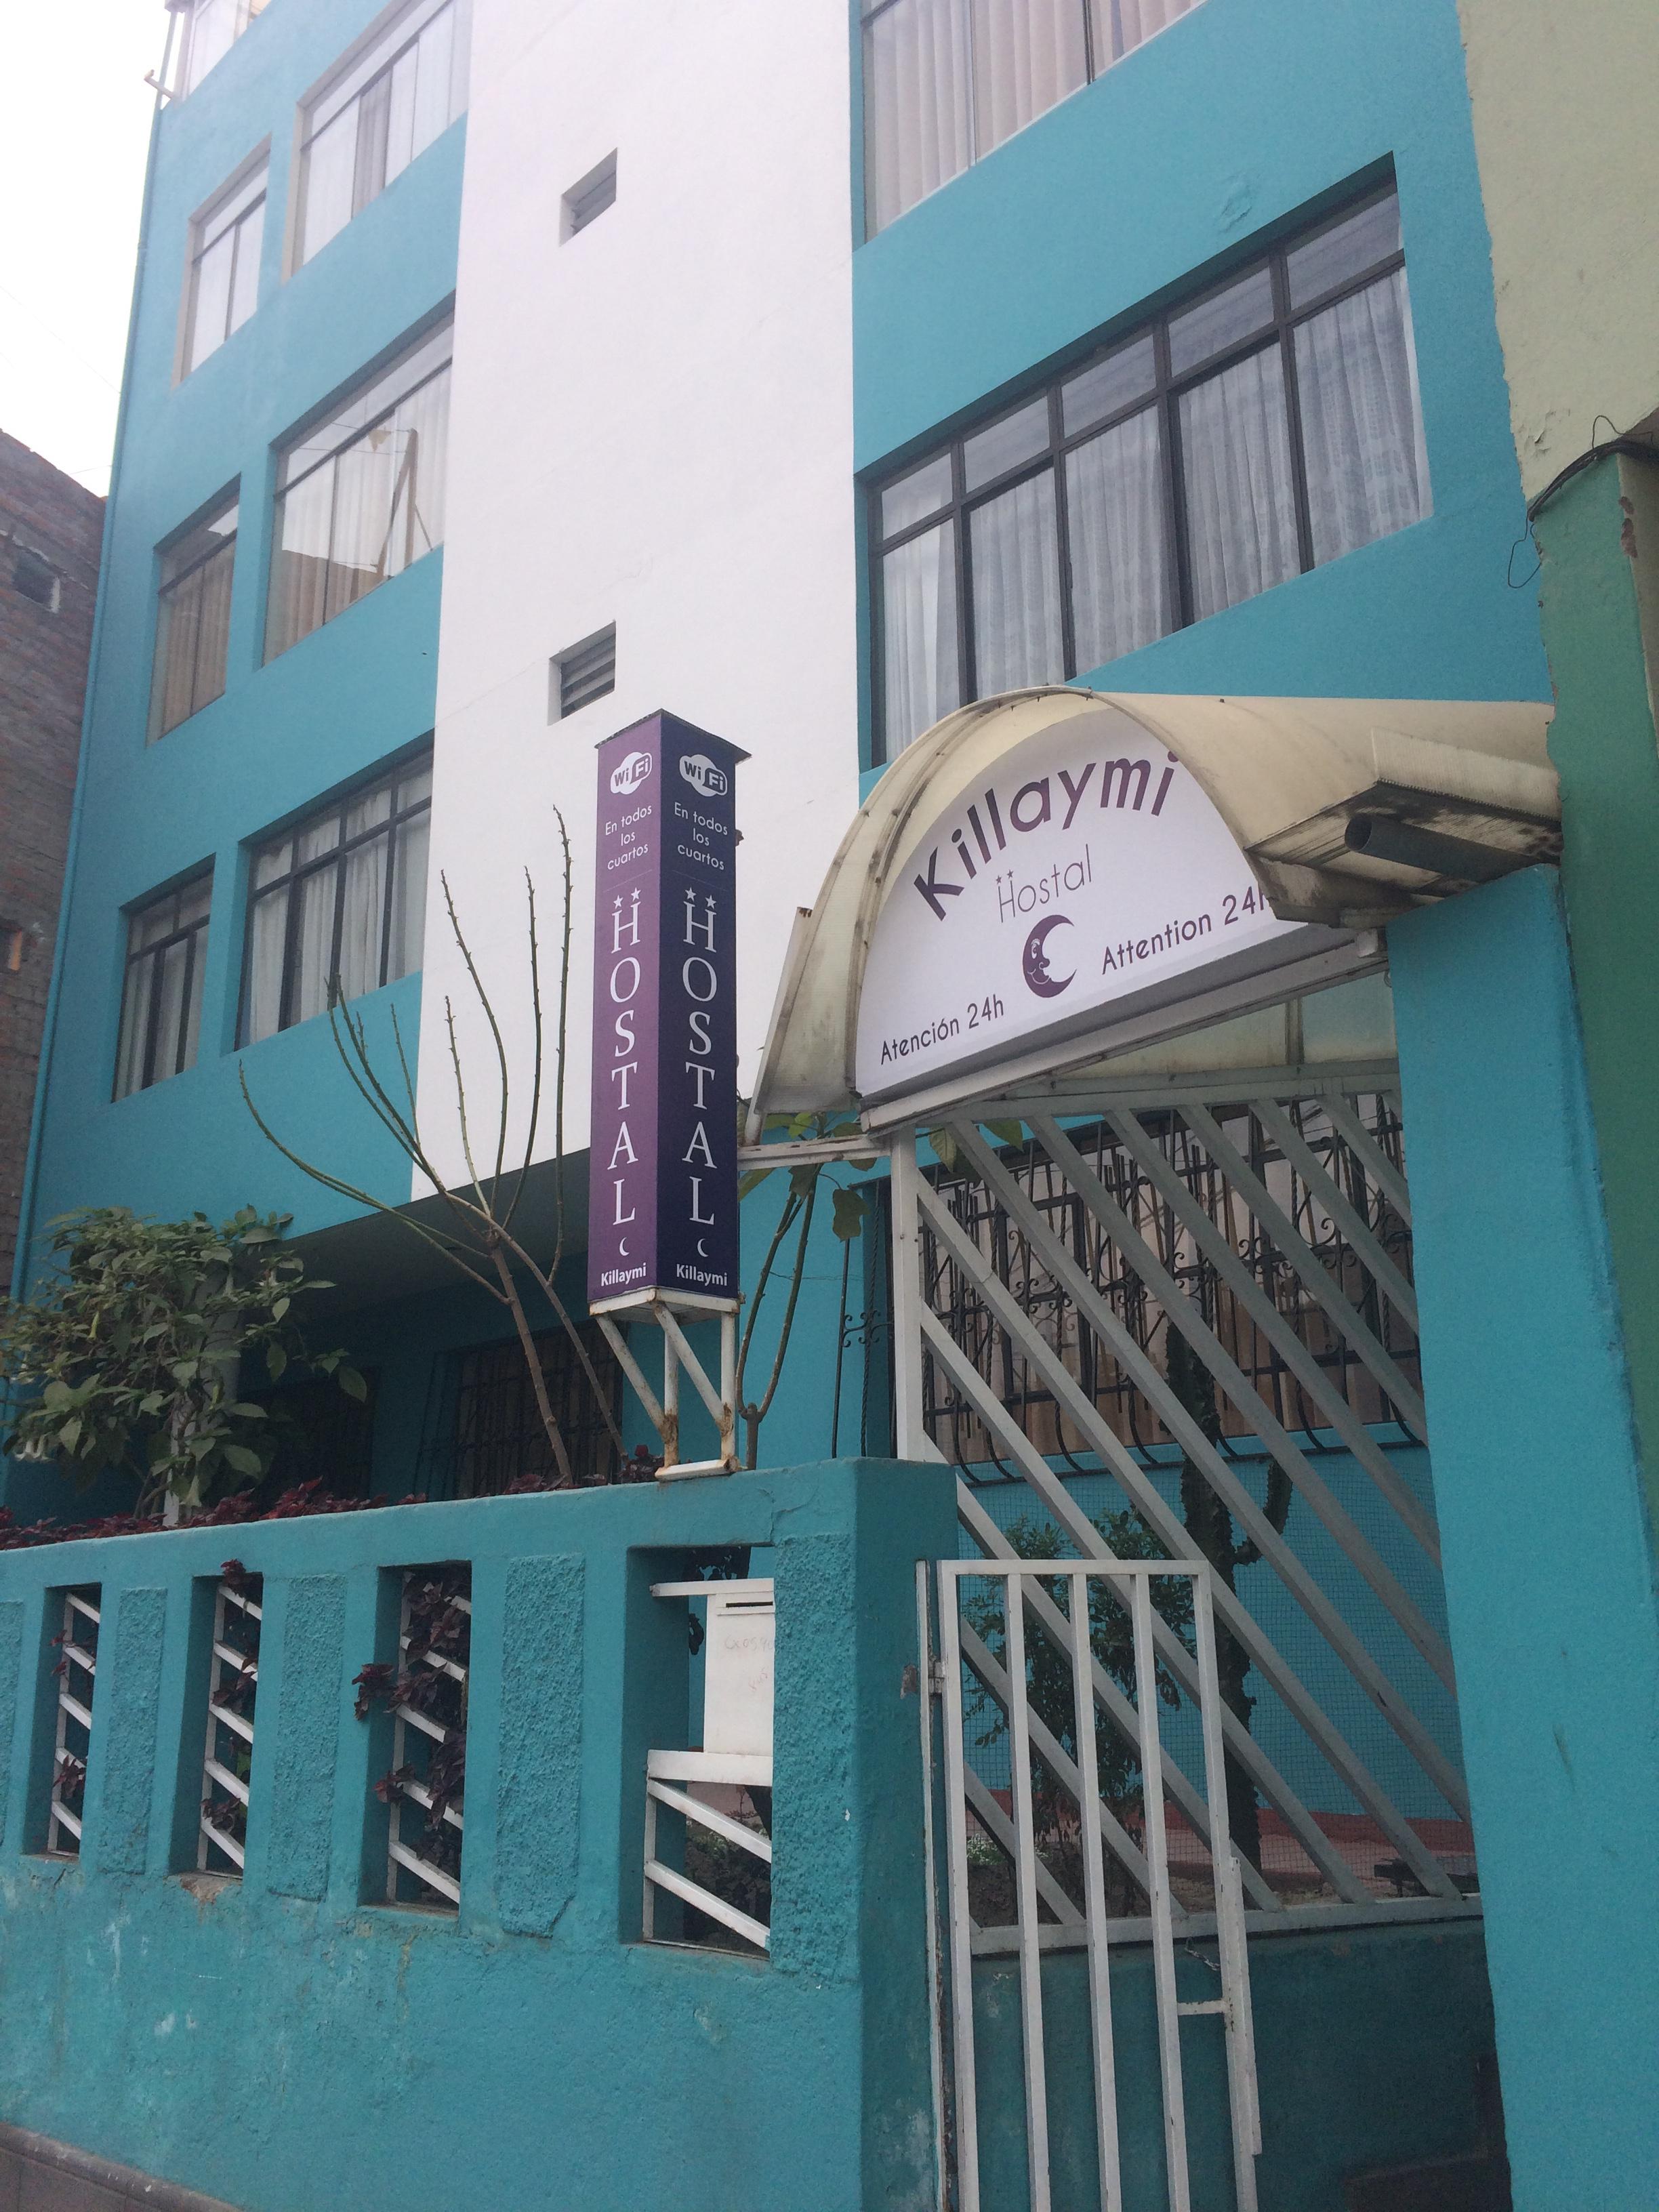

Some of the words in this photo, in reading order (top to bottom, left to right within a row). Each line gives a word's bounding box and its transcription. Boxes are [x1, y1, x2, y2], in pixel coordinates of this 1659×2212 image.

[605, 821, 618, 836] En
[621, 804, 653, 828] todos
[674, 802, 689, 819] En
[693, 811, 729, 836] todos
[620, 831, 636, 846] los
[693, 827, 710, 846] los
[913, 750, 1180, 922] Killaymi
[607, 843, 649, 870] cuartos
[677, 844, 725, 871] cuartos
[996, 842, 1093, 924] Hostal
[1101, 911, 1212, 976] Attention
[880, 1017, 960, 1066] Atención
[967, 992, 1005, 1031] 24h
[607, 900, 642, 1227] HOSTAL
[681, 899, 718, 1227] HOSTAL
[600, 1261, 647, 1287] Killaymi
[676, 1263, 729, 1287] Killaymi
